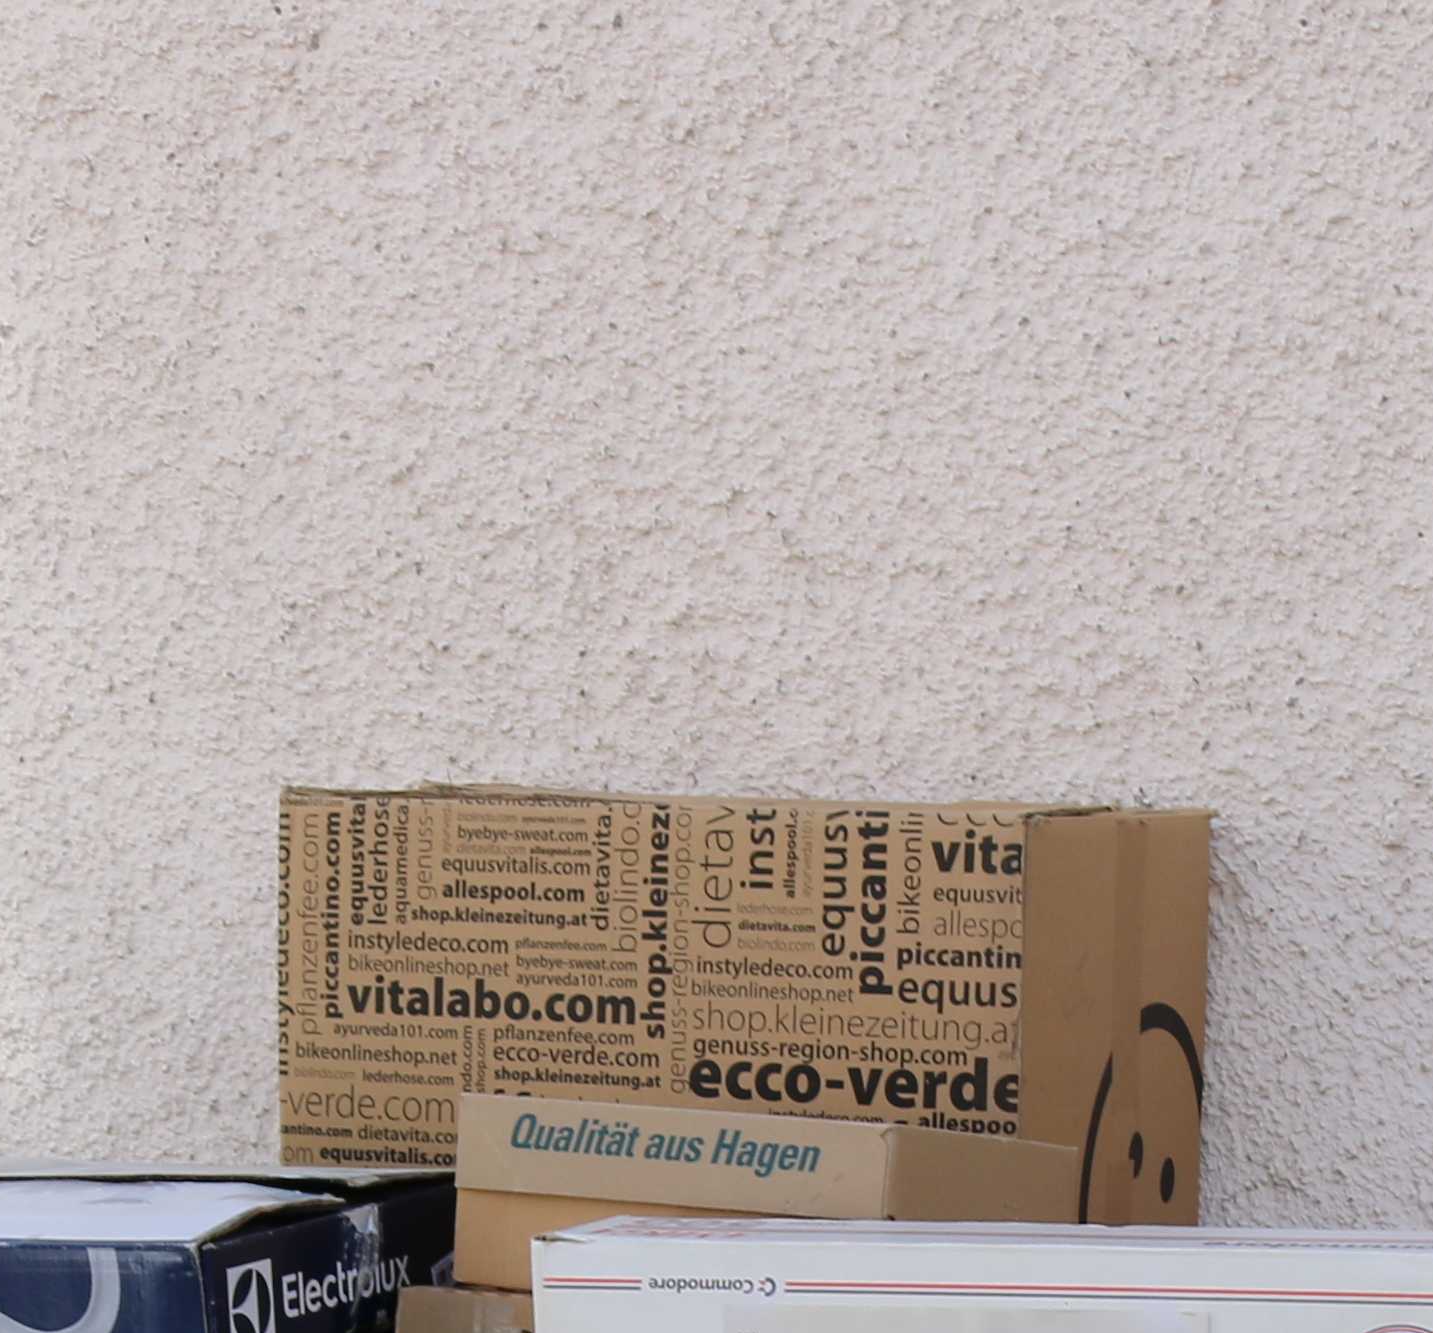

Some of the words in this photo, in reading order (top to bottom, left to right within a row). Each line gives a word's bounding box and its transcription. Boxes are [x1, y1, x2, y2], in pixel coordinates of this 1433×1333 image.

[457, 825, 589, 843] byebye-sweat.com
[369, 796, 391, 926] lederhose
[739, 807, 778, 891] inst
[931, 828, 1025, 876] vita
[441, 855, 591, 878] equusvitalis.com
[442, 880, 586, 903] allespool.com
[850, 809, 893, 995] piccanti
[296, 812, 321, 1036] pflanzenfee.com
[320, 811, 345, 1020] piccantino.com
[411, 905, 588, 929] shop.kleinezeitung.at
[348, 931, 510, 955] instyledeco.com
[347, 955, 510, 979] bikeonlineshop.net
[515, 954, 638, 974] byebye-sweat.com
[696, 956, 855, 981] instyledeco.com
[896, 943, 1024, 972] piccantin
[515, 973, 639, 991] ayurveda101.com
[690, 981, 856, 1005] bikeonlineshop.net
[347, 976, 636, 1025] vitalabo.com
[897, 976, 1020, 1014] equus
[333, 1023, 459, 1041] ayurveda101.com
[493, 1024, 635, 1046] pflanzenfee.com
[294, 1042, 459, 1067] bikeonlineshop.net
[493, 1043, 661, 1069] ecco-verde.com
[692, 1035, 969, 1068] genuss-region-shop.com
[493, 1066, 663, 1090] shop.kleinezeitung.at
[688, 1056, 1020, 1114] ecco-verde
[280, 1084, 457, 1124] -verde.com
[511, 1111, 640, 1158] Qualität
[644, 1133, 703, 1163] aus
[710, 1127, 822, 1178] Hagen
[281, 1255, 411, 1318] Electrolux
[648, 1276, 755, 1296] Commodore
